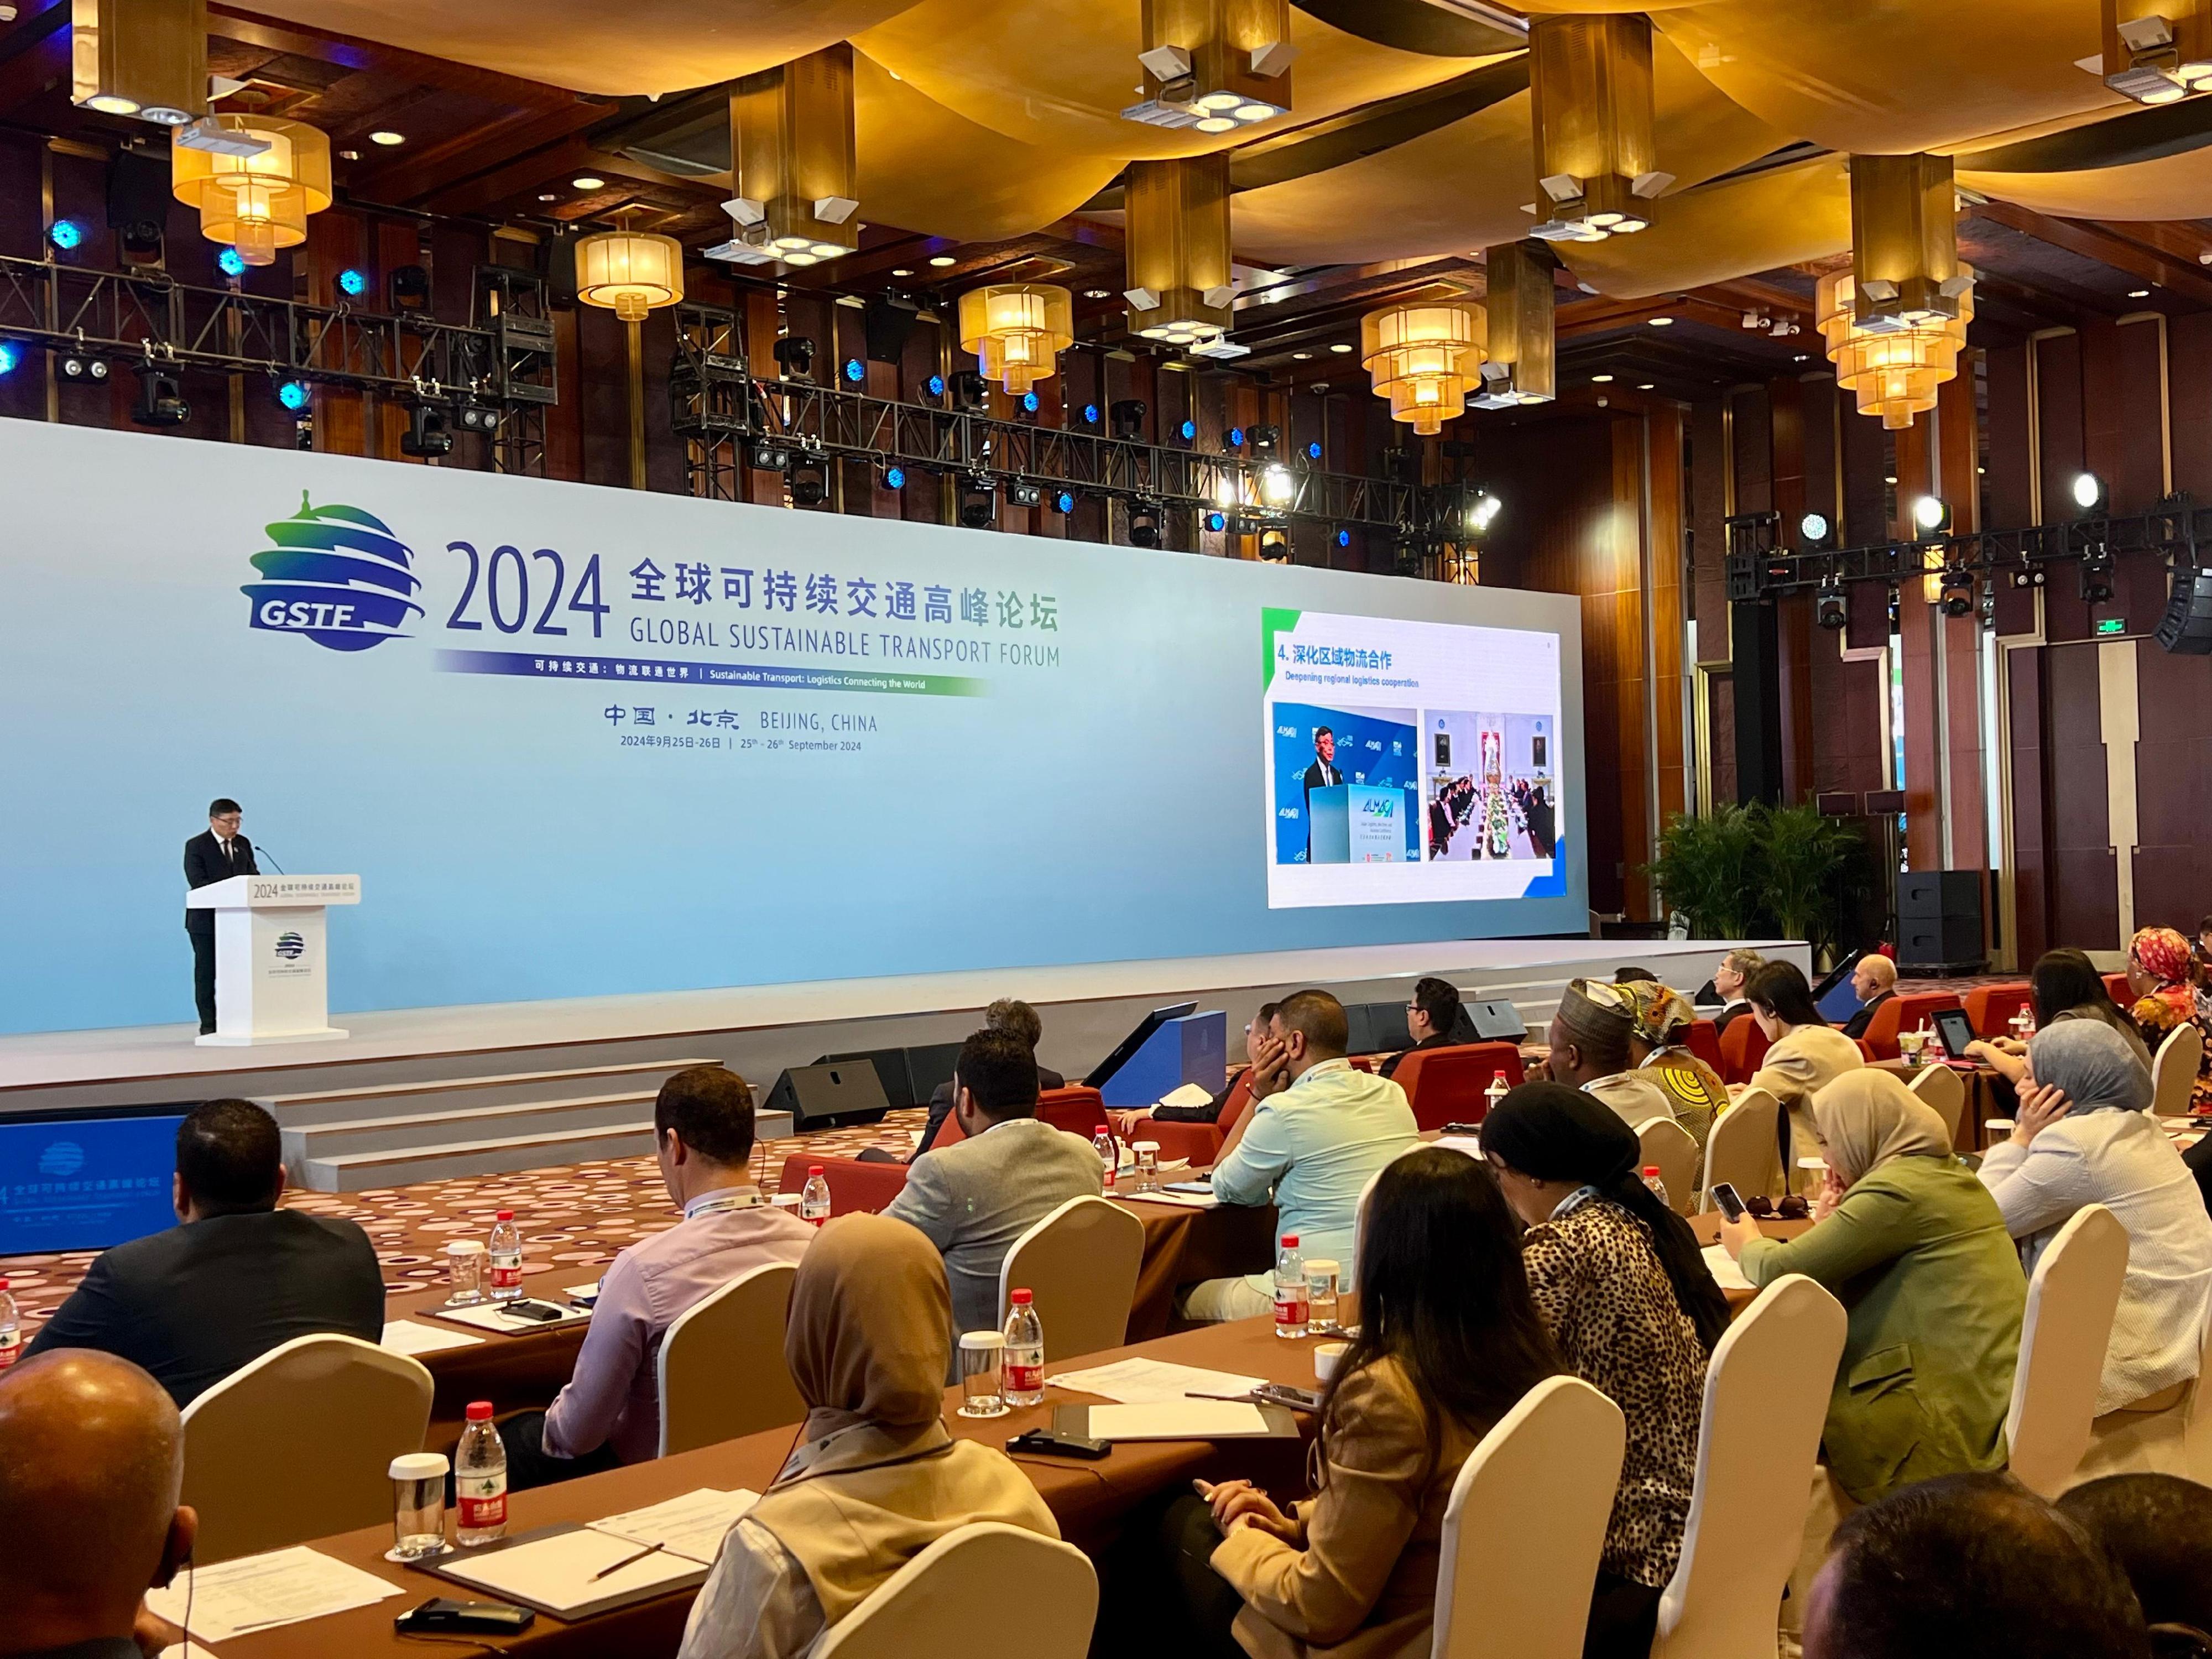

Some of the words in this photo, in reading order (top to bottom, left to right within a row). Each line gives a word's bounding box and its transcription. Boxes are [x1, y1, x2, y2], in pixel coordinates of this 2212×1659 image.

[446, 541, 610, 638] 2024
[629, 557, 1058, 632] 全球可持续交通高峰论坛
[260, 600, 355, 628] GSTE
[630, 617, 719, 646] GLOBAL
[729, 624, 870, 656] SUSTAINABLE
[879, 634, 991, 663] TRANSPORT
[1000, 643, 1059, 667] FORUM
[1277, 644, 1289, 661] 4.
[1292, 644, 1392, 670] 深化区域物流合作
[709, 669, 760, 681] Sustainable
[762, 672, 805, 685] Transport:
[807, 675, 842, 686] Logistics
[844, 676, 887, 689] Connecting
[889, 679, 902, 688] the
[903, 680, 925, 689] World
[1285, 671, 1322, 684] Deepening
[1324, 674, 1350, 685] regional
[1353, 675, 1380, 687] logistics
[1381, 679, 1419, 688] cooperation
[761, 711, 824, 733] BEIJING,
[831, 714, 878, 732] CHINA
[620, 734, 720, 749] 2024年9月25日-26日
[740, 739, 758, 749] 25th
[767, 739, 784, 749] 26th
[789, 741, 838, 752] September
[840, 742, 861, 752] 2024
[254, 884, 278, 898] 2024
